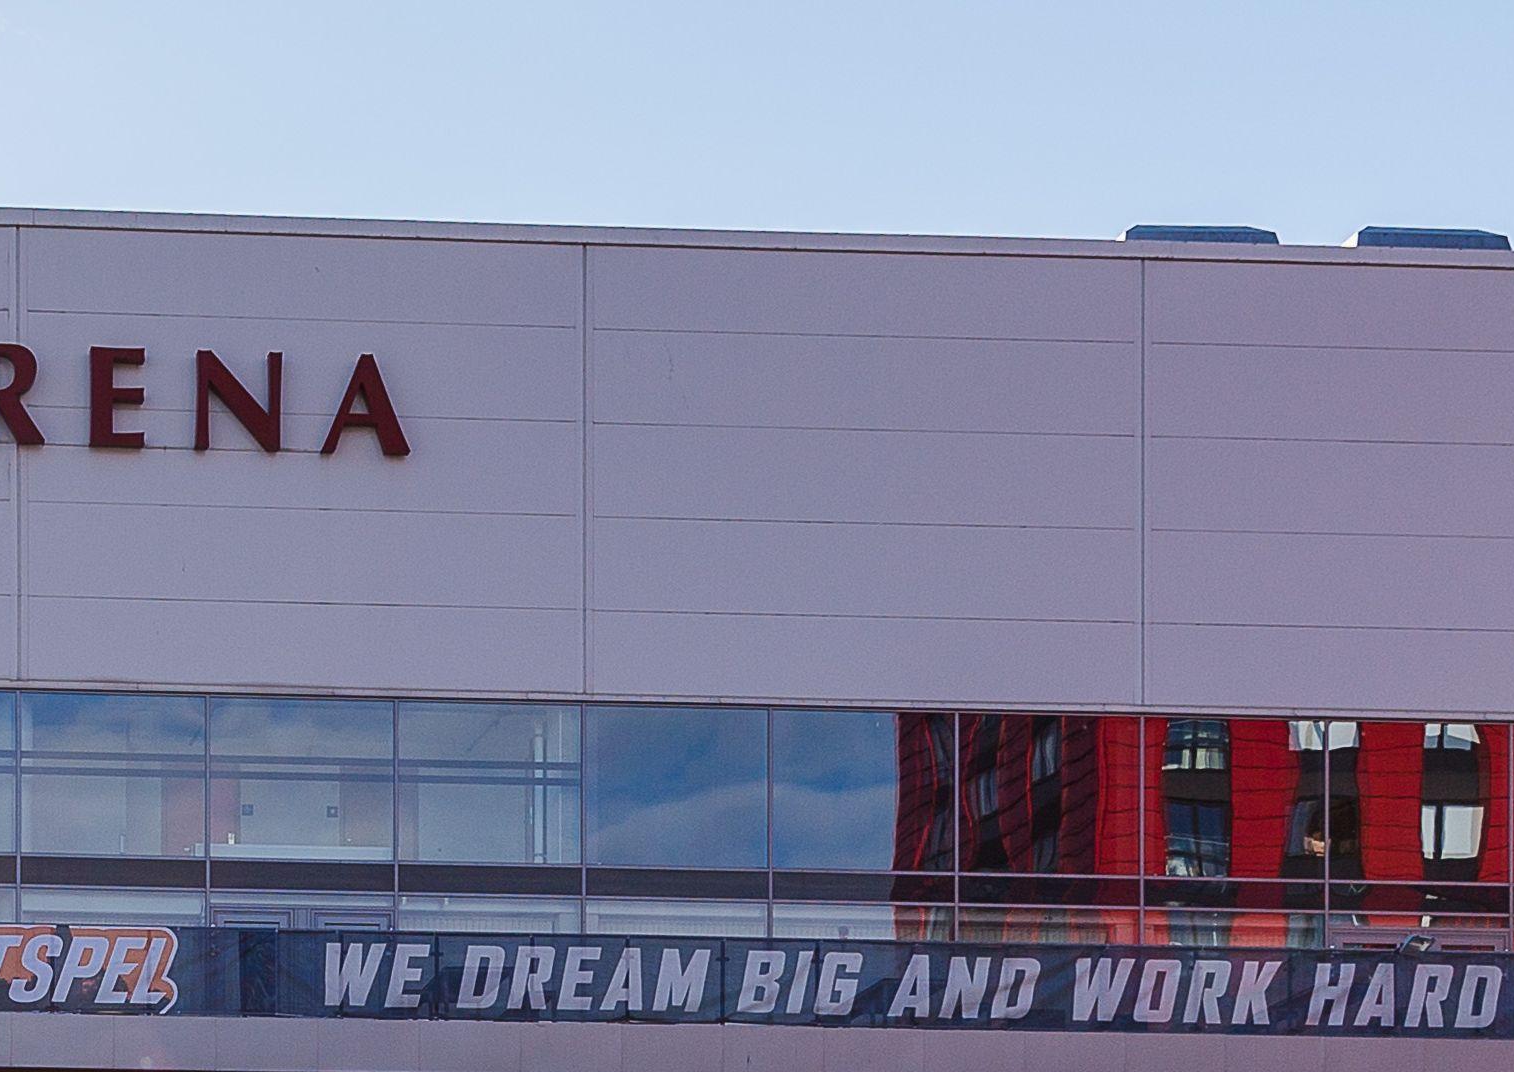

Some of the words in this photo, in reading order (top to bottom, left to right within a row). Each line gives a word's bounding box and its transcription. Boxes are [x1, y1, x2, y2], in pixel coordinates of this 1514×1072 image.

[324, 942, 428, 1010] WE
[455, 944, 711, 1014] DREAM
[738, 949, 865, 1017] BIG
[886, 954, 1042, 1020] AND
[1071, 957, 1284, 1026] WORK
[1303, 962, 1506, 1030] HARD
